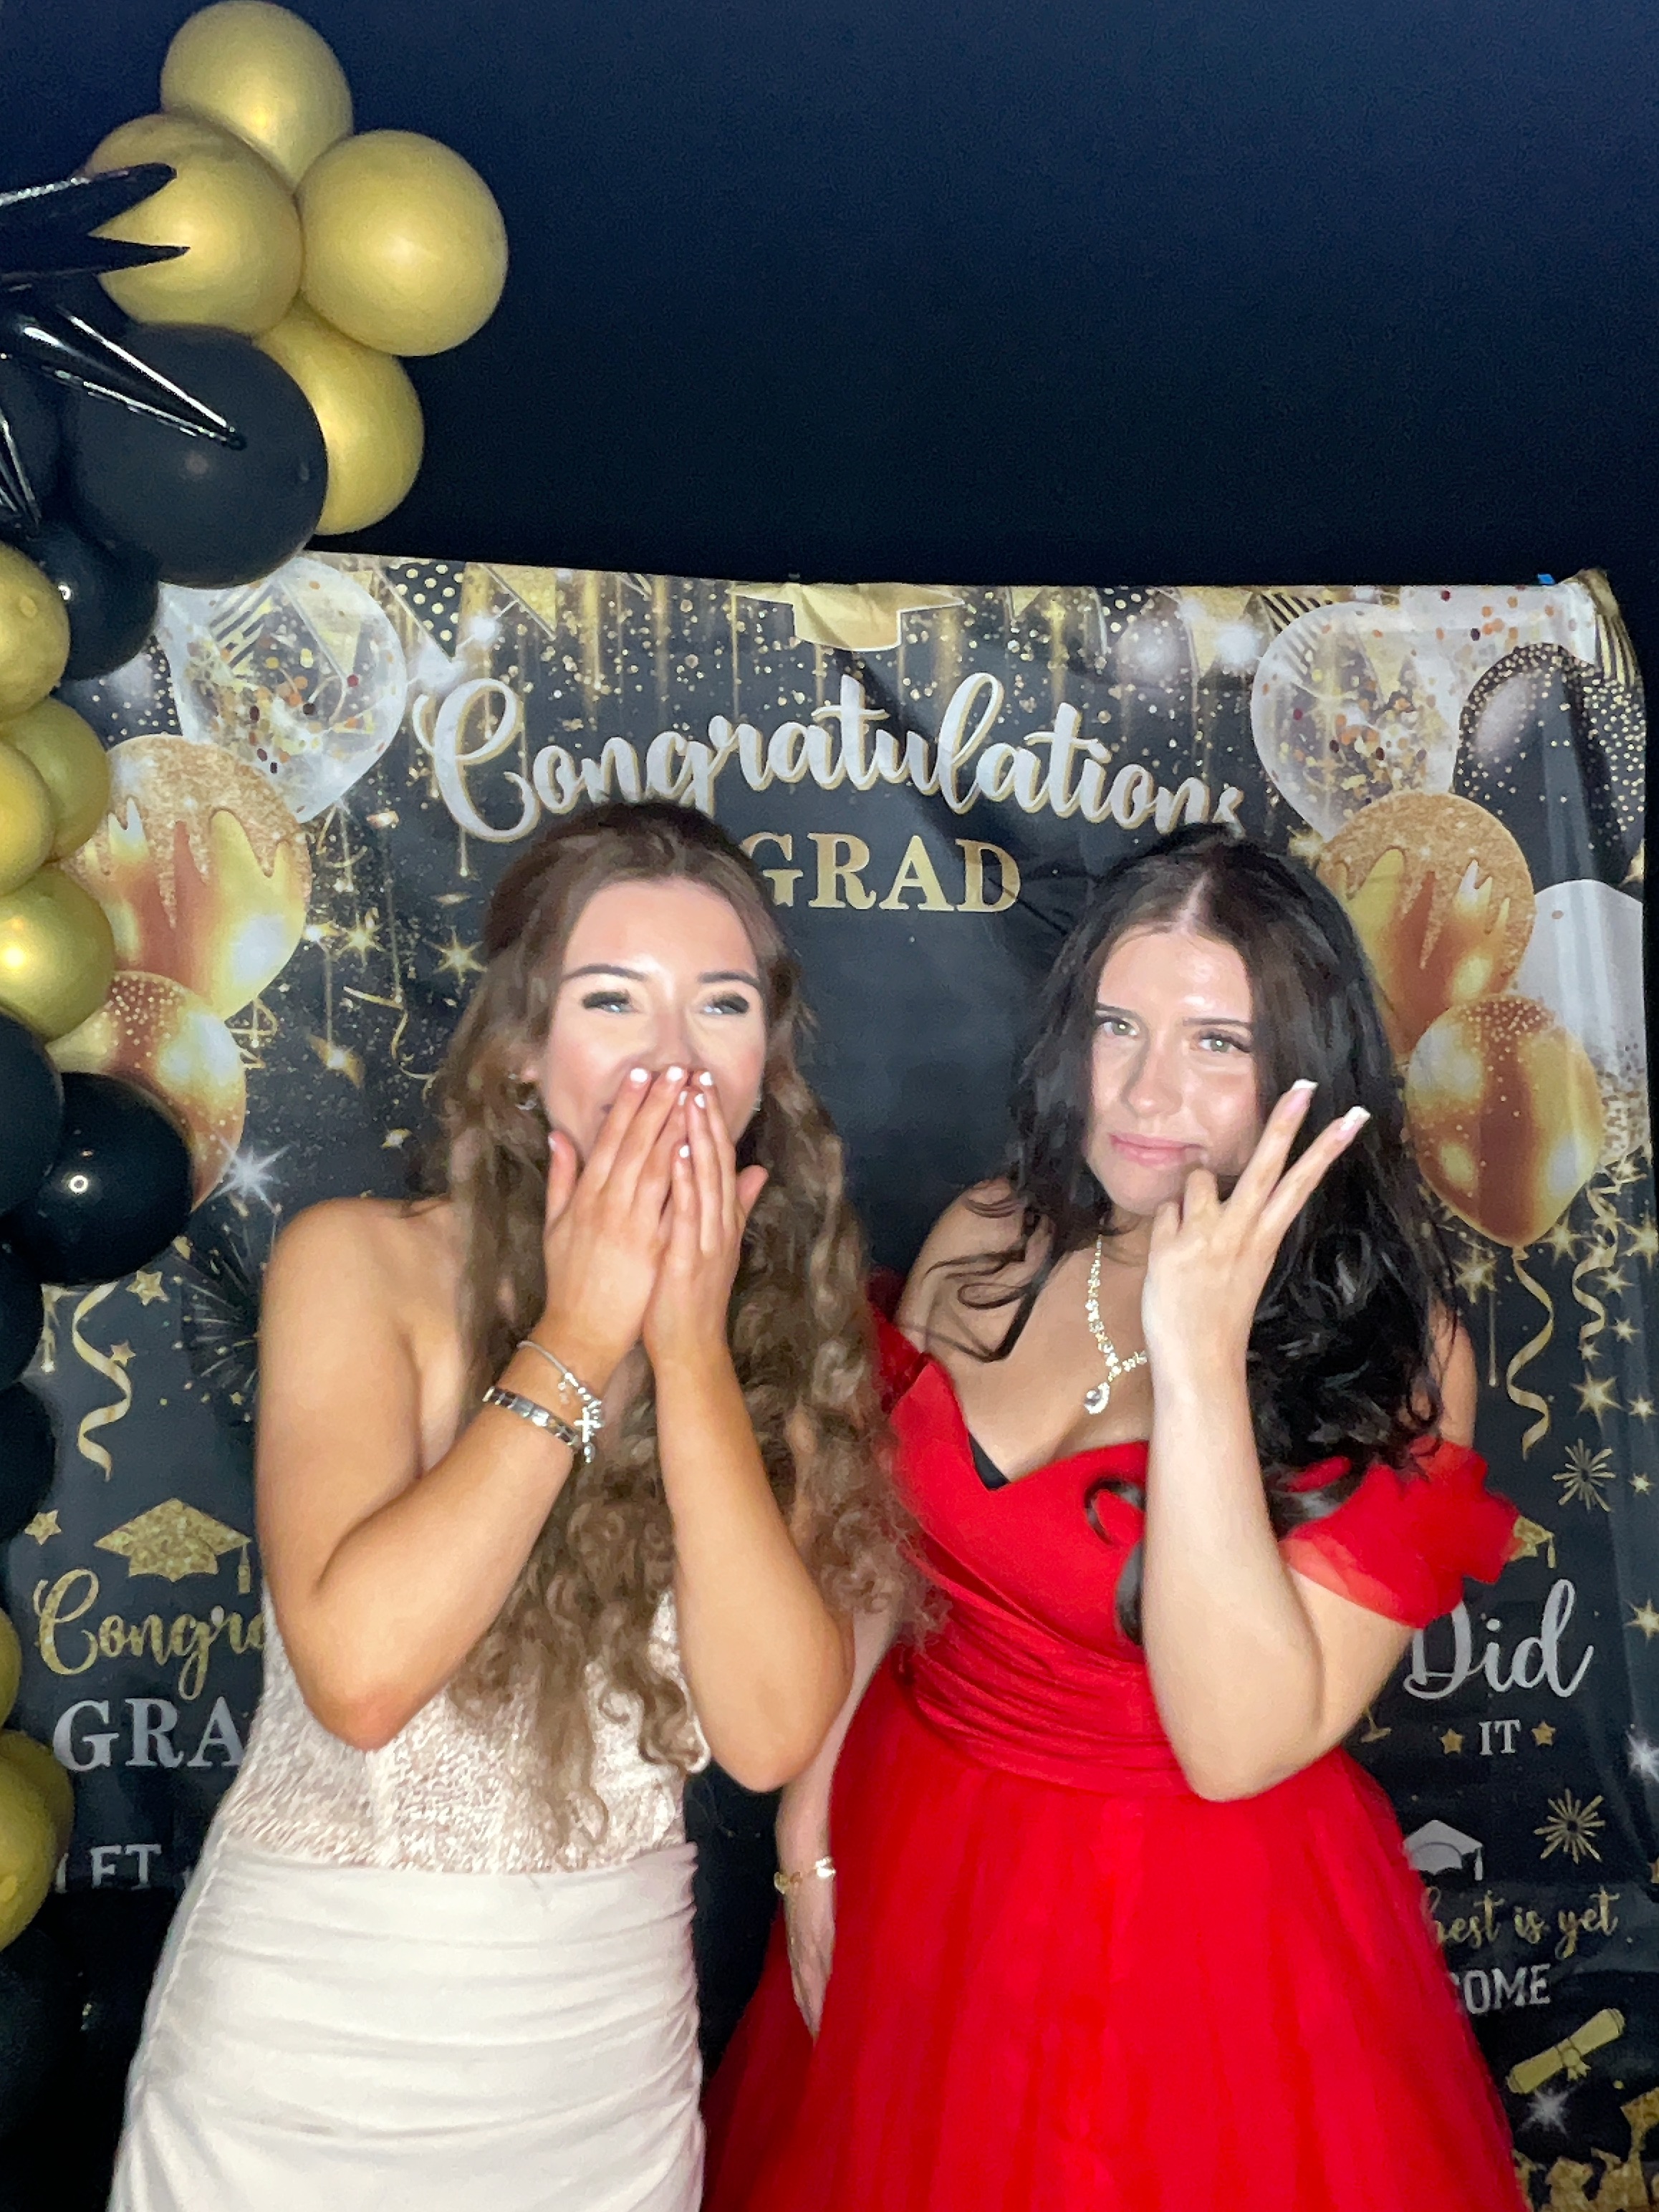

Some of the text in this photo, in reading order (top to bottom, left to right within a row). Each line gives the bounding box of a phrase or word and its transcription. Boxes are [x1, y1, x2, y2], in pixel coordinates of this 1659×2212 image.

[413, 670, 1246, 842] Congratulations
[740, 832, 1021, 912] GRAD
[1403, 1579, 1594, 1699] Did
[1478, 1719, 1521, 1755] IT
[1514, 1905, 1547, 1944] is
[1555, 1884, 1620, 1960] yet
[1450, 1963, 1552, 2014] OME
